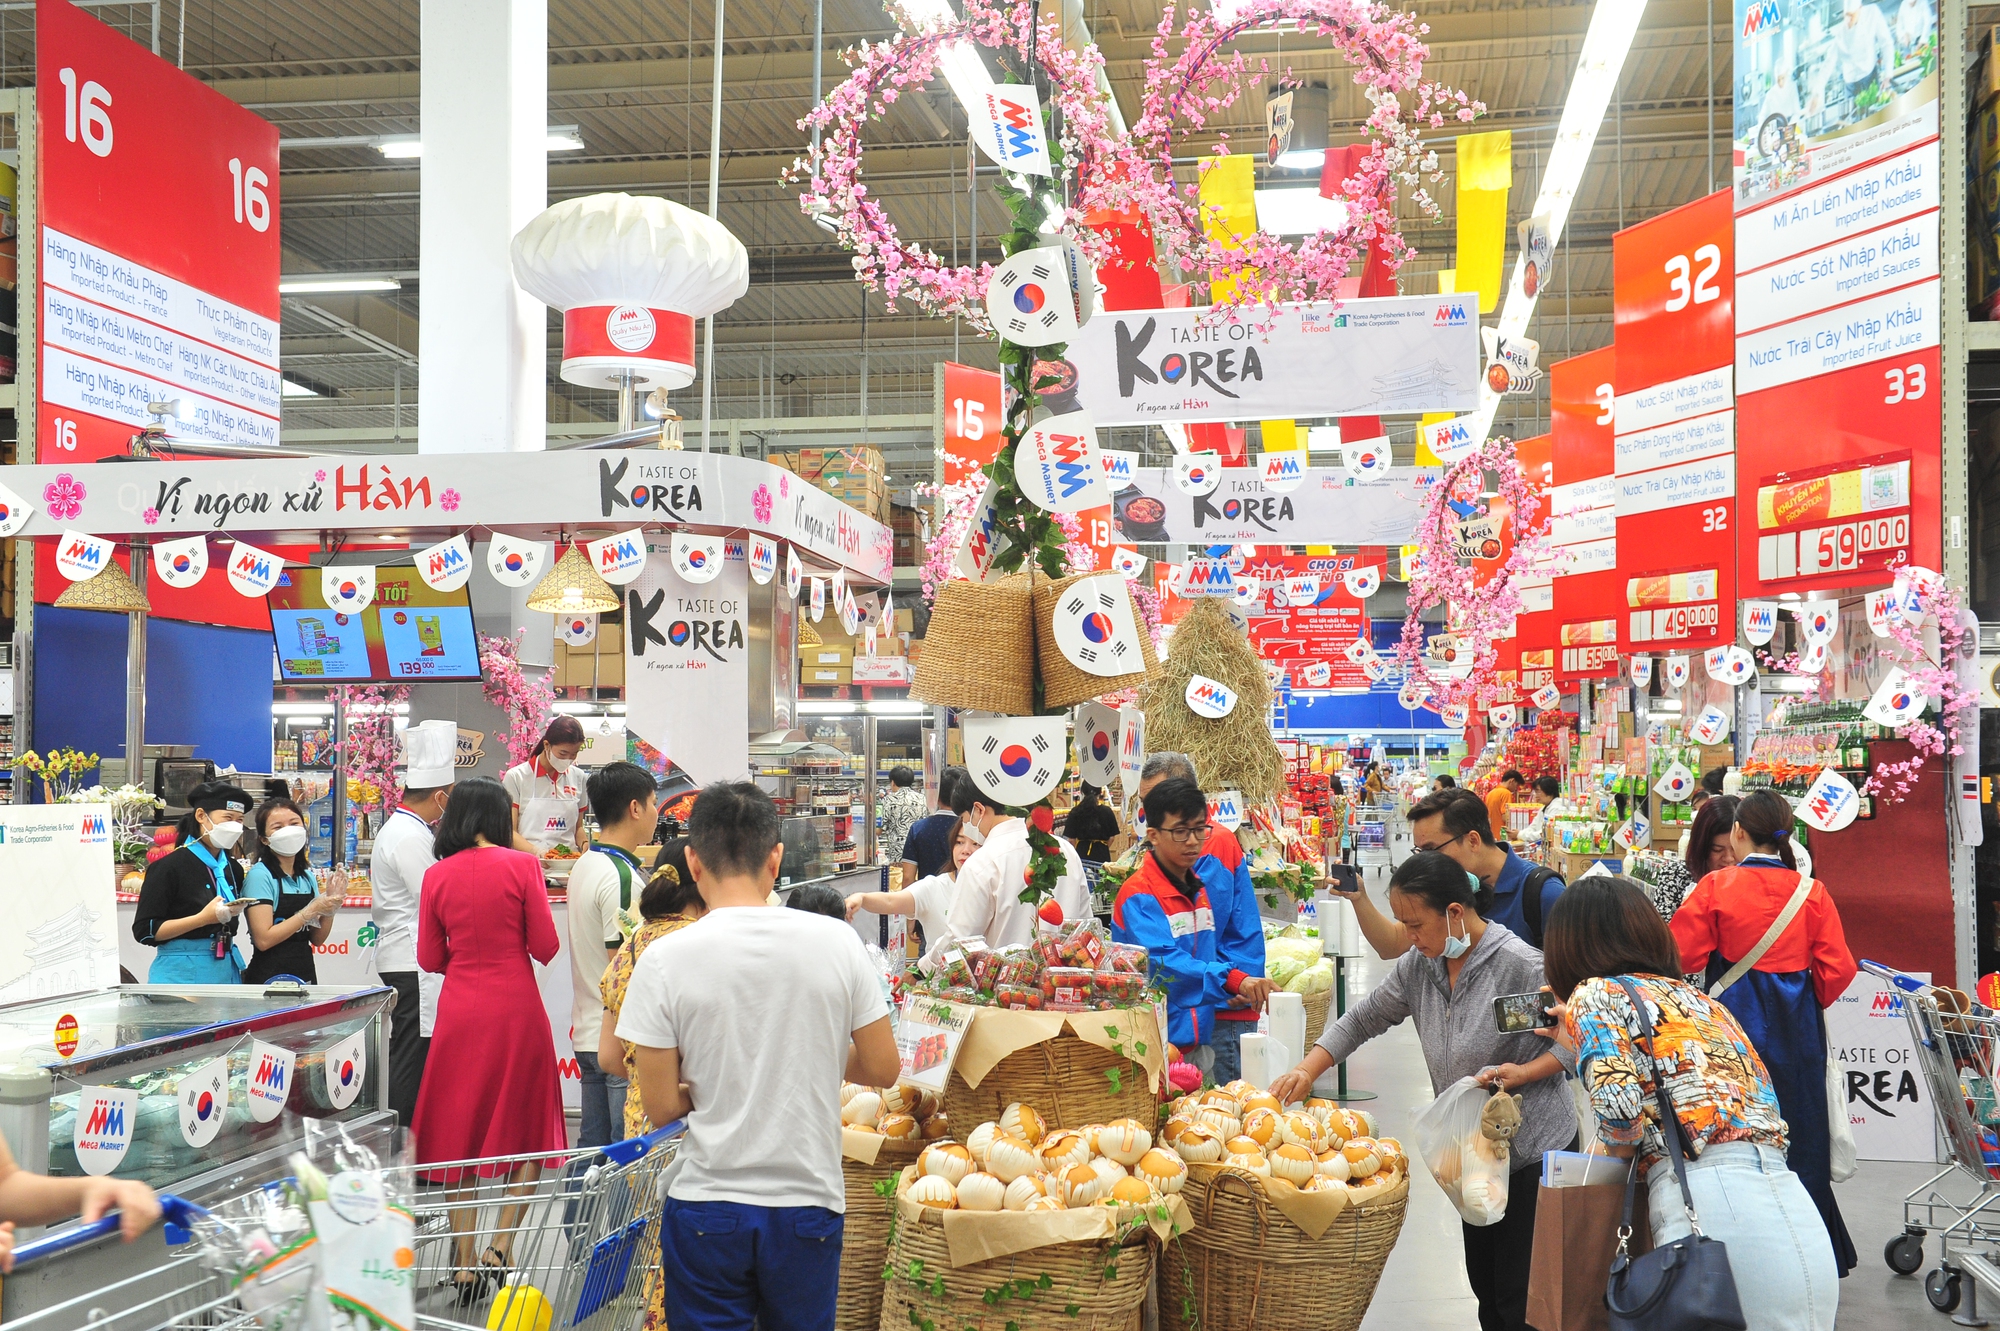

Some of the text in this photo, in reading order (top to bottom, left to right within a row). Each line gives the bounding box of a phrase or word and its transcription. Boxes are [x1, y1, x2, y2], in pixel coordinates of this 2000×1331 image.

[58, 66, 114, 158] 16
[228, 157, 271, 233] 16
[1791, 202, 1809, 225] Ăn
[1844, 179, 1880, 206] Nhập
[1884, 158, 1922, 190] Khẩu
[1834, 186, 1922, 228] Imported Noodles
[46, 237, 169, 304] Hàng Nhập Khẩu Pháp
[1664, 243, 1721, 313] 32
[1770, 227, 1921, 294] Nước Sốt Nhập Khẩu
[1836, 256, 1921, 292] Imported Sauces
[70, 270, 169, 319] Imported Product France
[48, 296, 74, 326] Hàng
[126, 326, 152, 348] Metro
[153, 337, 174, 357] Chef
[250, 321, 274, 346] Chay
[1170, 323, 1254, 344] TASTE OF
[1301, 324, 1331, 334] K-food
[1304, 313, 1321, 322] like
[1352, 313, 1369, 321] Korea
[1352, 319, 1400, 328] Trade Corporation
[1749, 301, 1922, 368] Nước Trái Cây Nhập Khẩu
[61, 324, 174, 373] Imported Product Metro Chef
[178, 344, 199, 371] Hàng
[199, 354, 212, 370] NK
[1114, 315, 1264, 399] KOREA
[1822, 330, 1922, 367] Imported Fruit Juice
[65, 362, 126, 399] Hàng Nhập
[1884, 363, 1927, 405] 33
[80, 389, 144, 419] Imported Product
[953, 397, 985, 441] 15
[1182, 397, 1210, 410] Hàn
[1674, 394, 1724, 413] Imported Sauces
[53, 416, 78, 452] 16
[1685, 440, 1708, 453] Canned
[1708, 436, 1725, 448] Good
[599, 456, 703, 523] KOREA
[638, 465, 698, 481] TASTE OF
[1709, 484, 1725, 496] Juice
[154, 476, 192, 523] Vị
[194, 490, 272, 528] ngon
[282, 480, 324, 514] xứ
[335, 462, 433, 512] Hàn
[837, 508, 862, 557] Hàn
[1090, 518, 1110, 548] 13
[1460, 525, 1493, 543] KOREA
[1701, 505, 1728, 533] 32
[383, 583, 408, 602] TỐT
[677, 598, 738, 615] TASTE OF
[628, 587, 744, 663] KOREA
[398, 661, 422, 675] 139
[686, 659, 707, 670] Hàn
[10, 834, 53, 844] Trade Corporation
[1838, 1047, 1910, 1065] ASTE OF
[1845, 1069, 1919, 1118] REA
